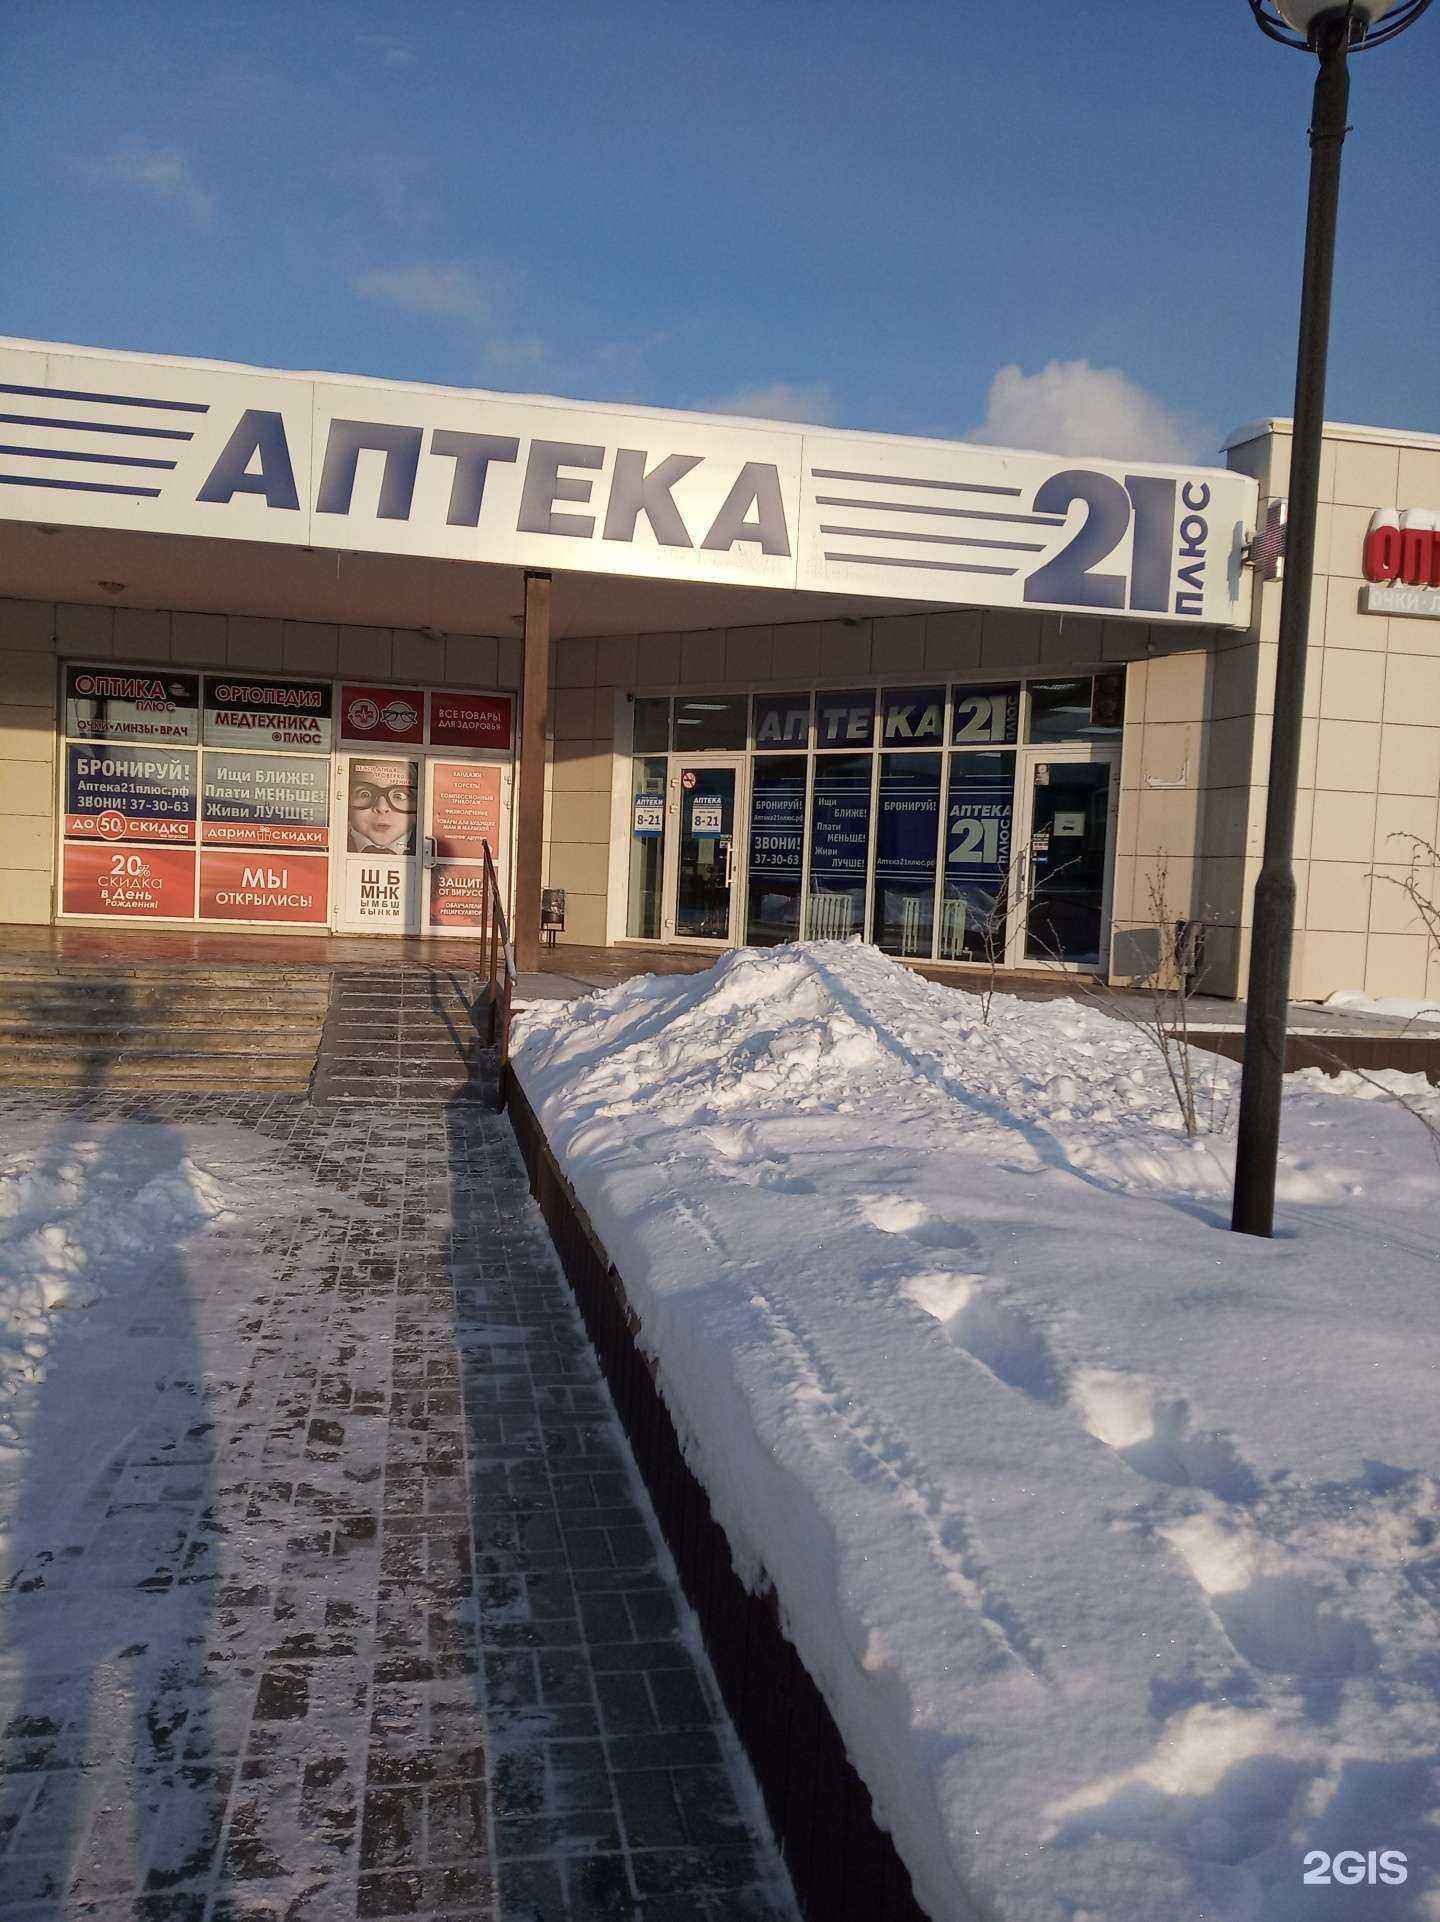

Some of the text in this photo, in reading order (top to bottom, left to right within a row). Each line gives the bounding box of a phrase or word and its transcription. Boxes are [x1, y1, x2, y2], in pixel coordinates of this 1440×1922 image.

[195, 409, 792, 558] АПТЕКА
[1023, 469, 1177, 613] 21
[1175, 480, 1211, 616] ПЛЮС
[76, 675, 167, 699] ОПТИКА
[215, 685, 322, 707] ОРТОПЕДИЯ
[136, 699, 176, 712] ПЛЮС
[215, 711, 321, 732] МЕДТЕХНИКА
[439, 709, 501, 721] ВСЕ ТОВАРЫ
[955, 696, 1006, 742] 21
[438, 720, 501, 730] ДЛЯ ЗДОРОВЬЯ
[283, 732, 322, 745] ПЛЮС
[77, 759, 190, 780] БРОНИРУЙ!
[217, 768, 314, 786] Ищи БЛИЖЕ!
[78, 780, 189, 798] Аптека21плюс.рф
[205, 784, 326, 804] Плати МЕНЬШЕ!
[77, 796, 189, 812] ЗВОНИ! 37-30-63
[755, 799, 802, 810] БРОНИРУЙ!
[818, 798, 837, 807] Ищи
[884, 799, 937, 811] БРОНИРУЙ!
[206, 803, 314, 821] Живи ЛУЧШЕ!
[834, 808, 867, 817] БЛИЖЕ!
[949, 805, 1012, 816] АПТЕКА
[637, 814, 661, 825] 8-21
[694, 815, 719, 827] 8-21
[816, 822, 841, 831] Плати
[754, 836, 800, 850] ЗВОНИ!
[827, 833, 866, 843] МЕНЬШЕ!
[949, 818, 999, 863] 21
[814, 847, 838, 855] Живи
[754, 853, 799, 864] 37-30-63
[831, 858, 865, 868] ЛУЧШЕ!
[241, 868, 288, 889] МЫ
[361, 869, 400, 885] Ш Б
[439, 877, 484, 889] ЗАЩИТ
[112, 889, 152, 901] День
[216, 892, 312, 908] ОТКРЫЛИСЬ!
[105, 899, 158, 909] Рождения!
